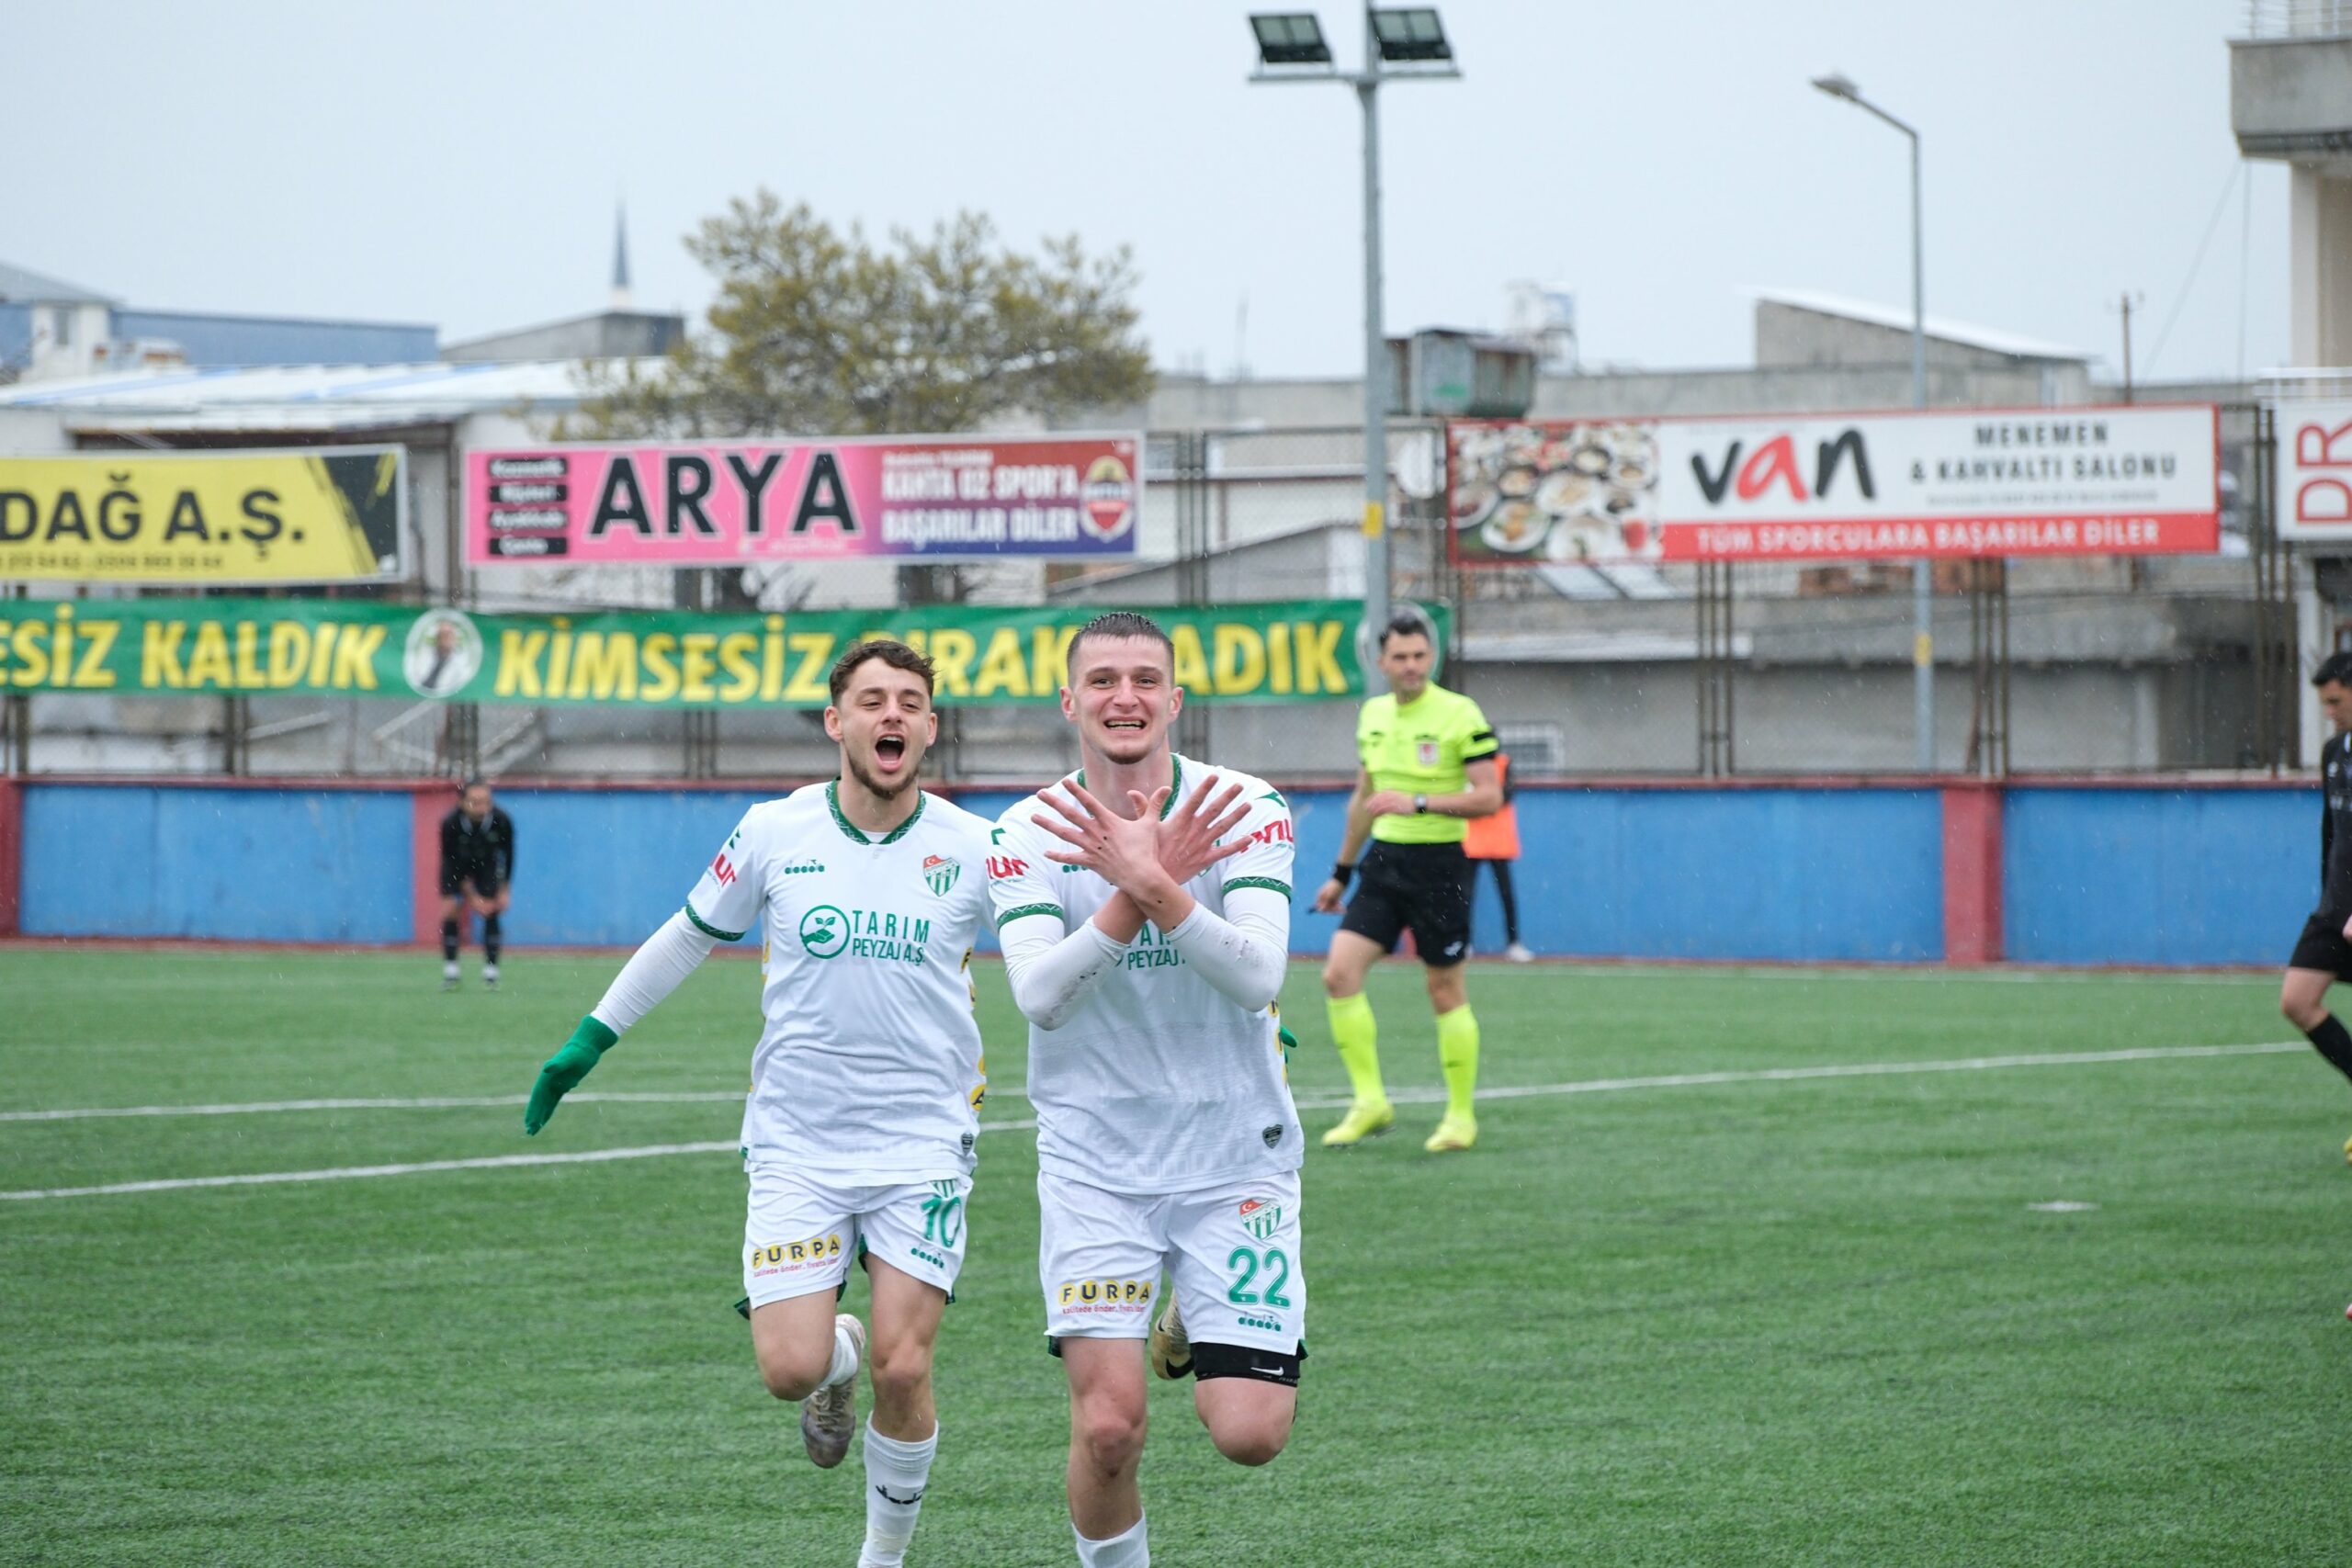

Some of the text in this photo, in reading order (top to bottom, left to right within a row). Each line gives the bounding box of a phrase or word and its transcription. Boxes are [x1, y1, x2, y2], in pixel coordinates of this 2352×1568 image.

[1974, 421, 2109, 448] MENEMEN
[1910, 453, 2177, 484] & KAHVALTI SALONU
[590, 453, 856, 535] ARYA
[0, 471, 306, 559] DAĞ A.Ş.
[1758, 523, 1929, 551] SPORCULARA
[2084, 517, 2159, 547] DİLER
[0, 604, 120, 689] SİZ
[141, 617, 387, 691] KALDIK
[494, 615, 836, 703] KİMSESİZ
[852, 909, 930, 944] TARIM
[853, 937, 901, 961] PEYZAJ
[1127, 948, 1179, 971] PEYZAJ
[921, 1195, 962, 1248] 10
[752, 1237, 841, 1268] FURPA
[1061, 1282, 1150, 1303] FURPA
[1227, 1246, 1291, 1310] 22
